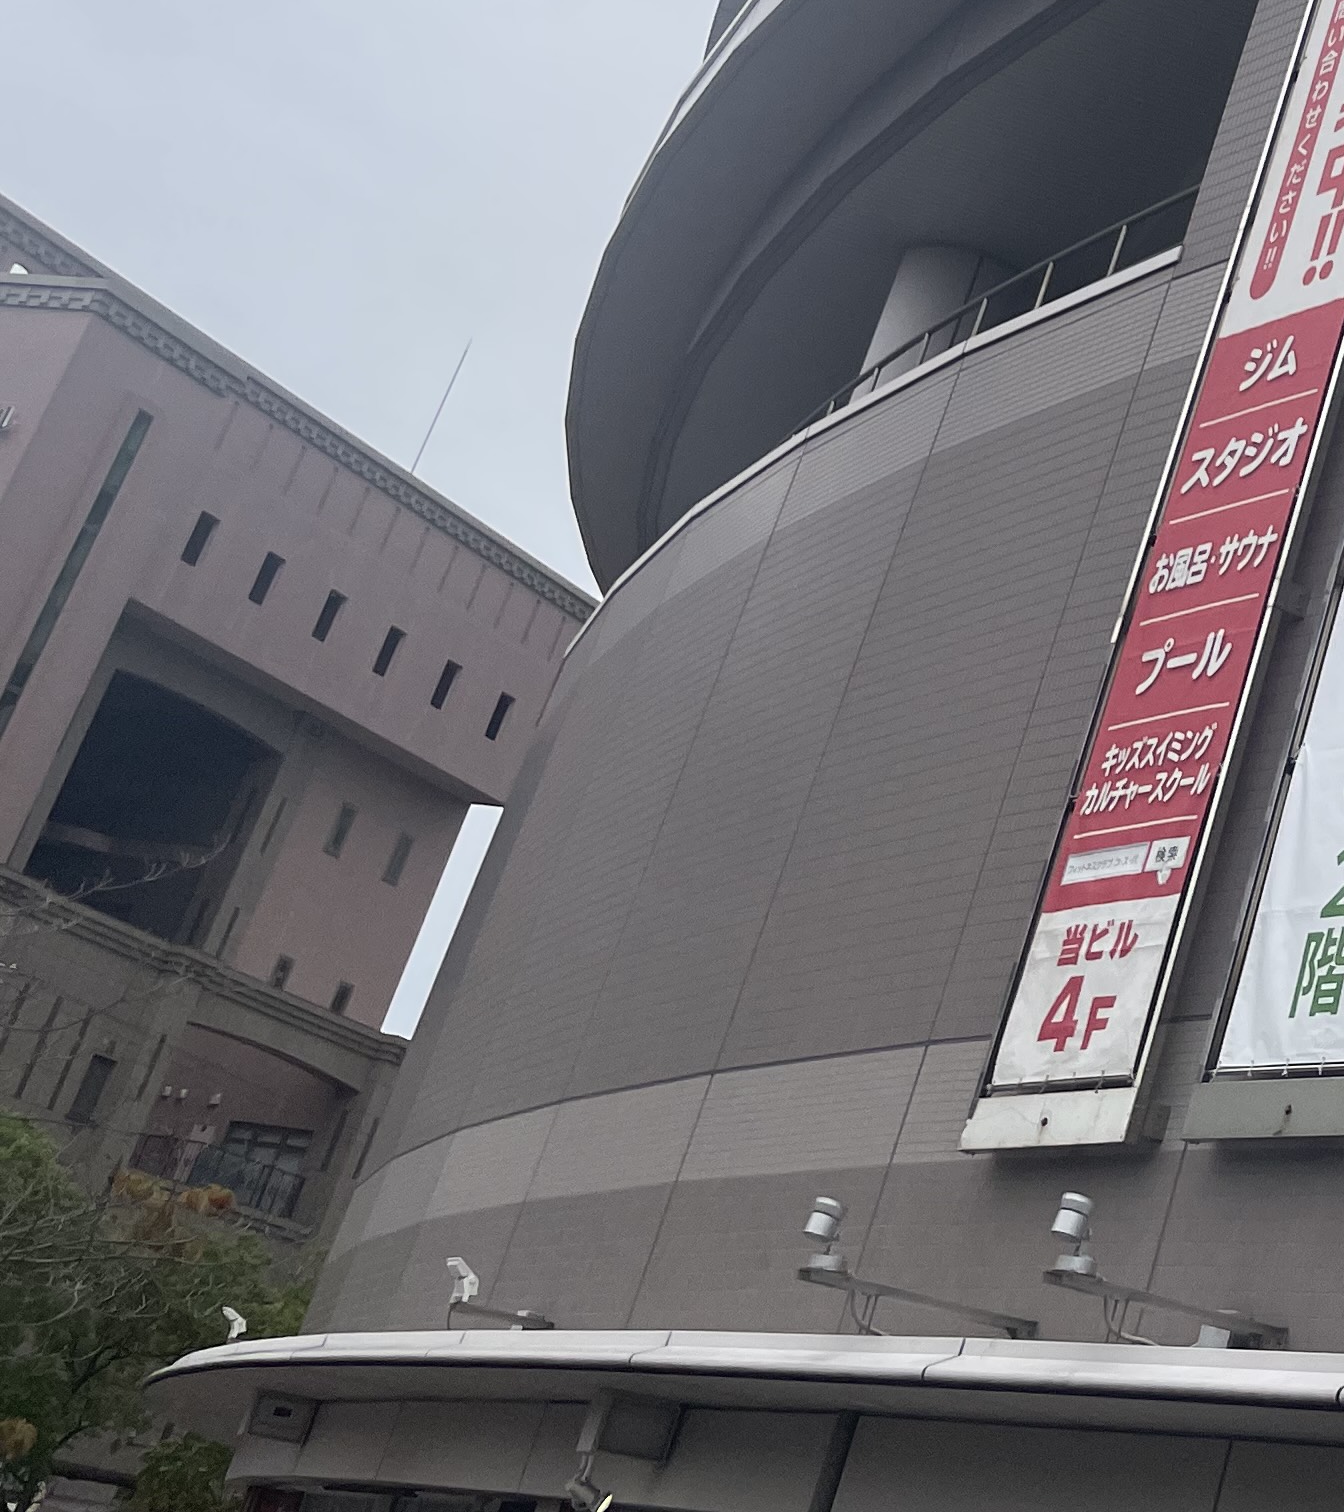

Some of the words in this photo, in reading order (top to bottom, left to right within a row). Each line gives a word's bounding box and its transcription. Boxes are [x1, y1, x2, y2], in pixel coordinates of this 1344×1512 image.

[1239, 335, 1298, 392] ジム
[1180, 417, 1309, 494] スタジオ
[1149, 525, 1279, 594] お風呂・サウナ
[1135, 629, 1234, 695] プール
[1102, 722, 1217, 777] キッズスイミング
[1080, 763, 1211, 815] カルチャースクール
[1057, 919, 1139, 967] 当ビル
[1037, 975, 1117, 1052] 4F
